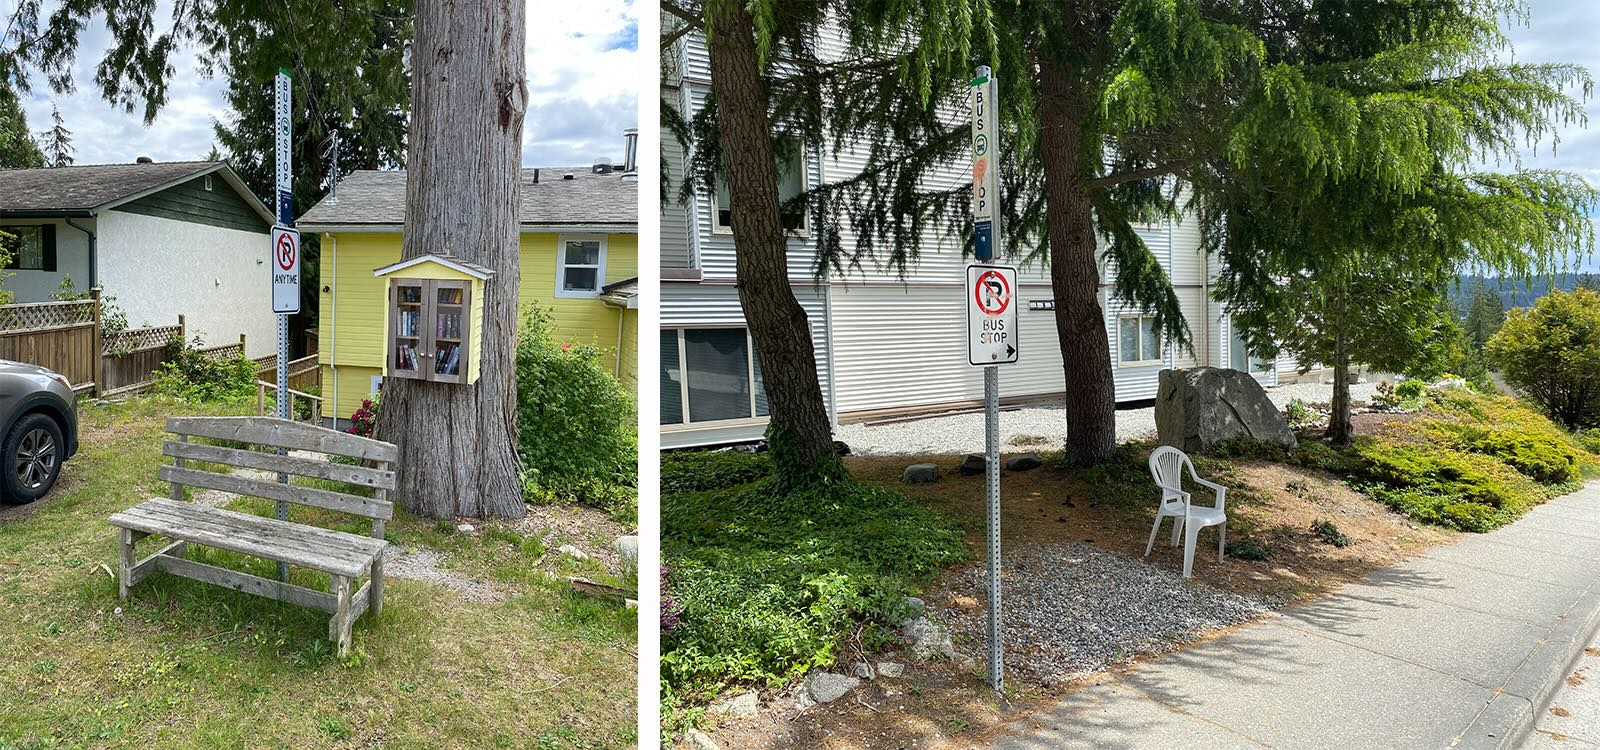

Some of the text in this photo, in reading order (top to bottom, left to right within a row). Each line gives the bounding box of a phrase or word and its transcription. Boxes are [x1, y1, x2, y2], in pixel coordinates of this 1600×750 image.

[976, 92, 984, 130] BUS
[274, 274, 297, 285] ANYTIME
[983, 320, 1005, 331] BUS
[980, 332, 1008, 344] STOP
